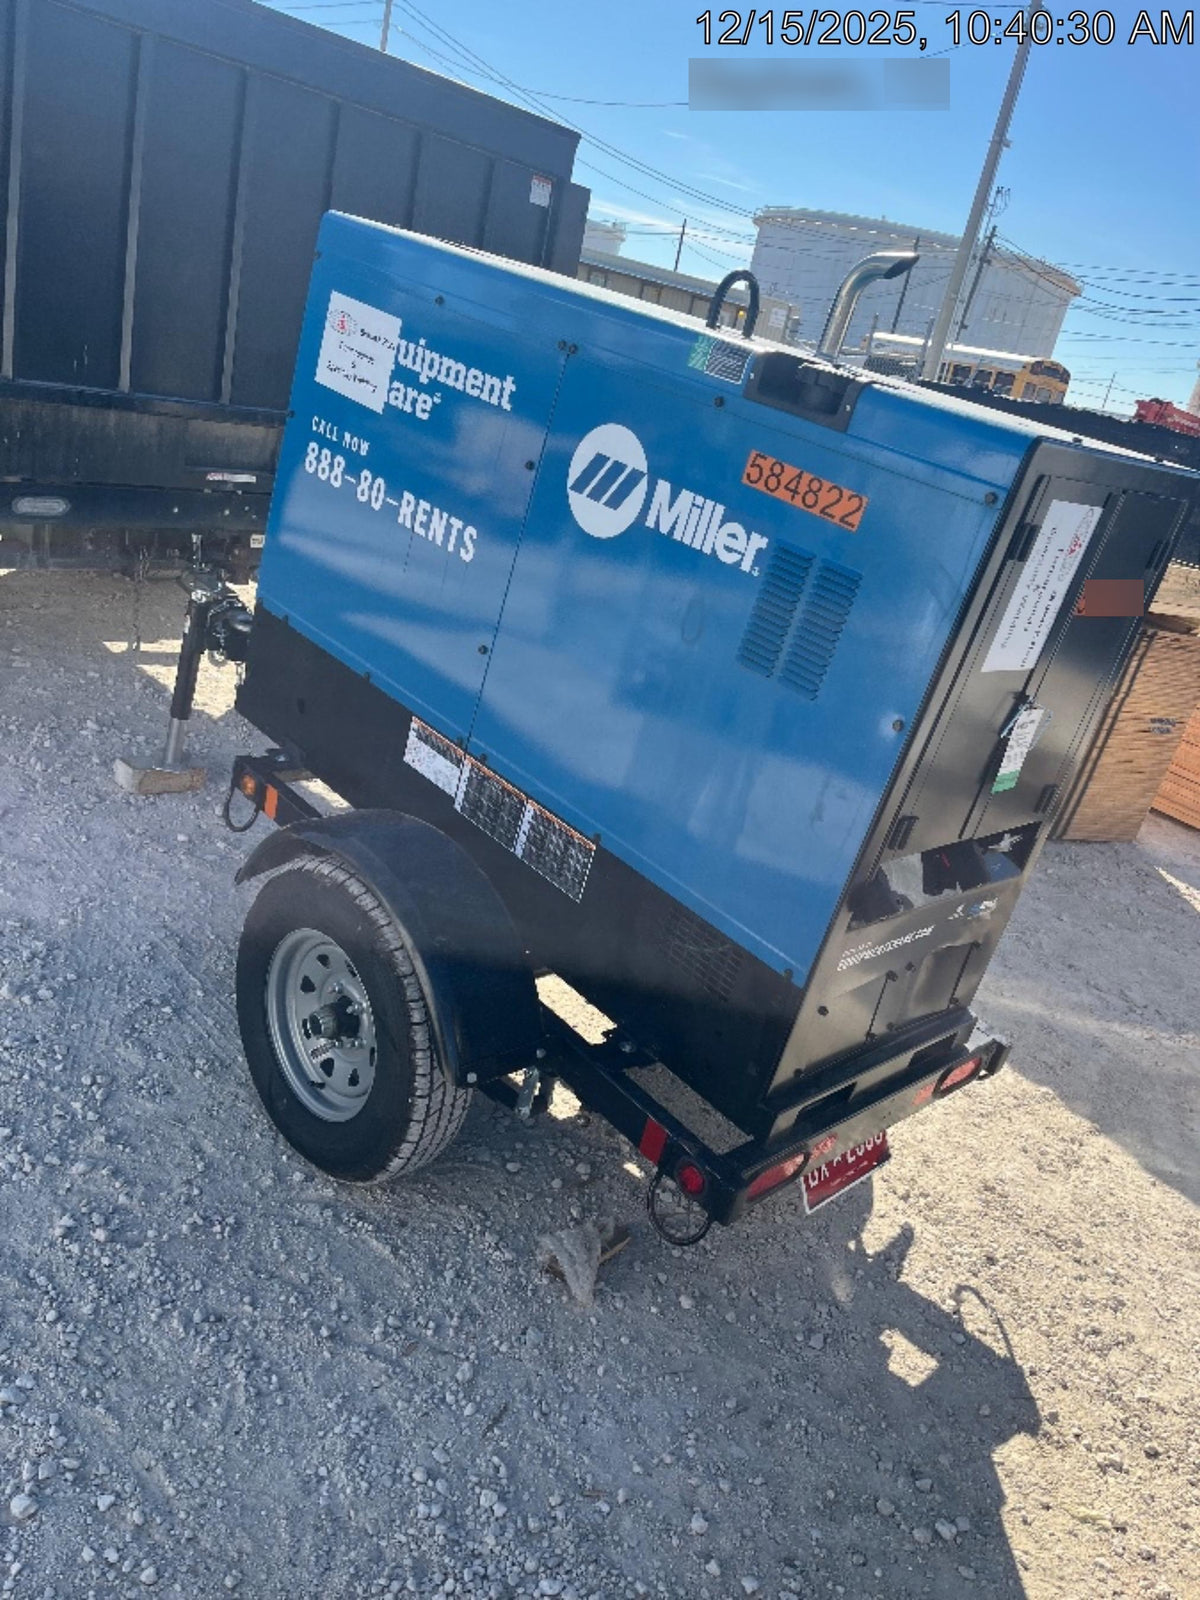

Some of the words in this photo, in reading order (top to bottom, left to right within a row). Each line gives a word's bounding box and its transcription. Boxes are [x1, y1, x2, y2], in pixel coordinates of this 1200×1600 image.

[398, 337, 516, 411] uipment
[312, 415, 338, 441] CALL
[342, 431, 370, 456] NOW
[305, 441, 478, 562] 888-80-RENTS
[644, 478, 769, 574] Miller
[746, 453, 863, 529] 584822
